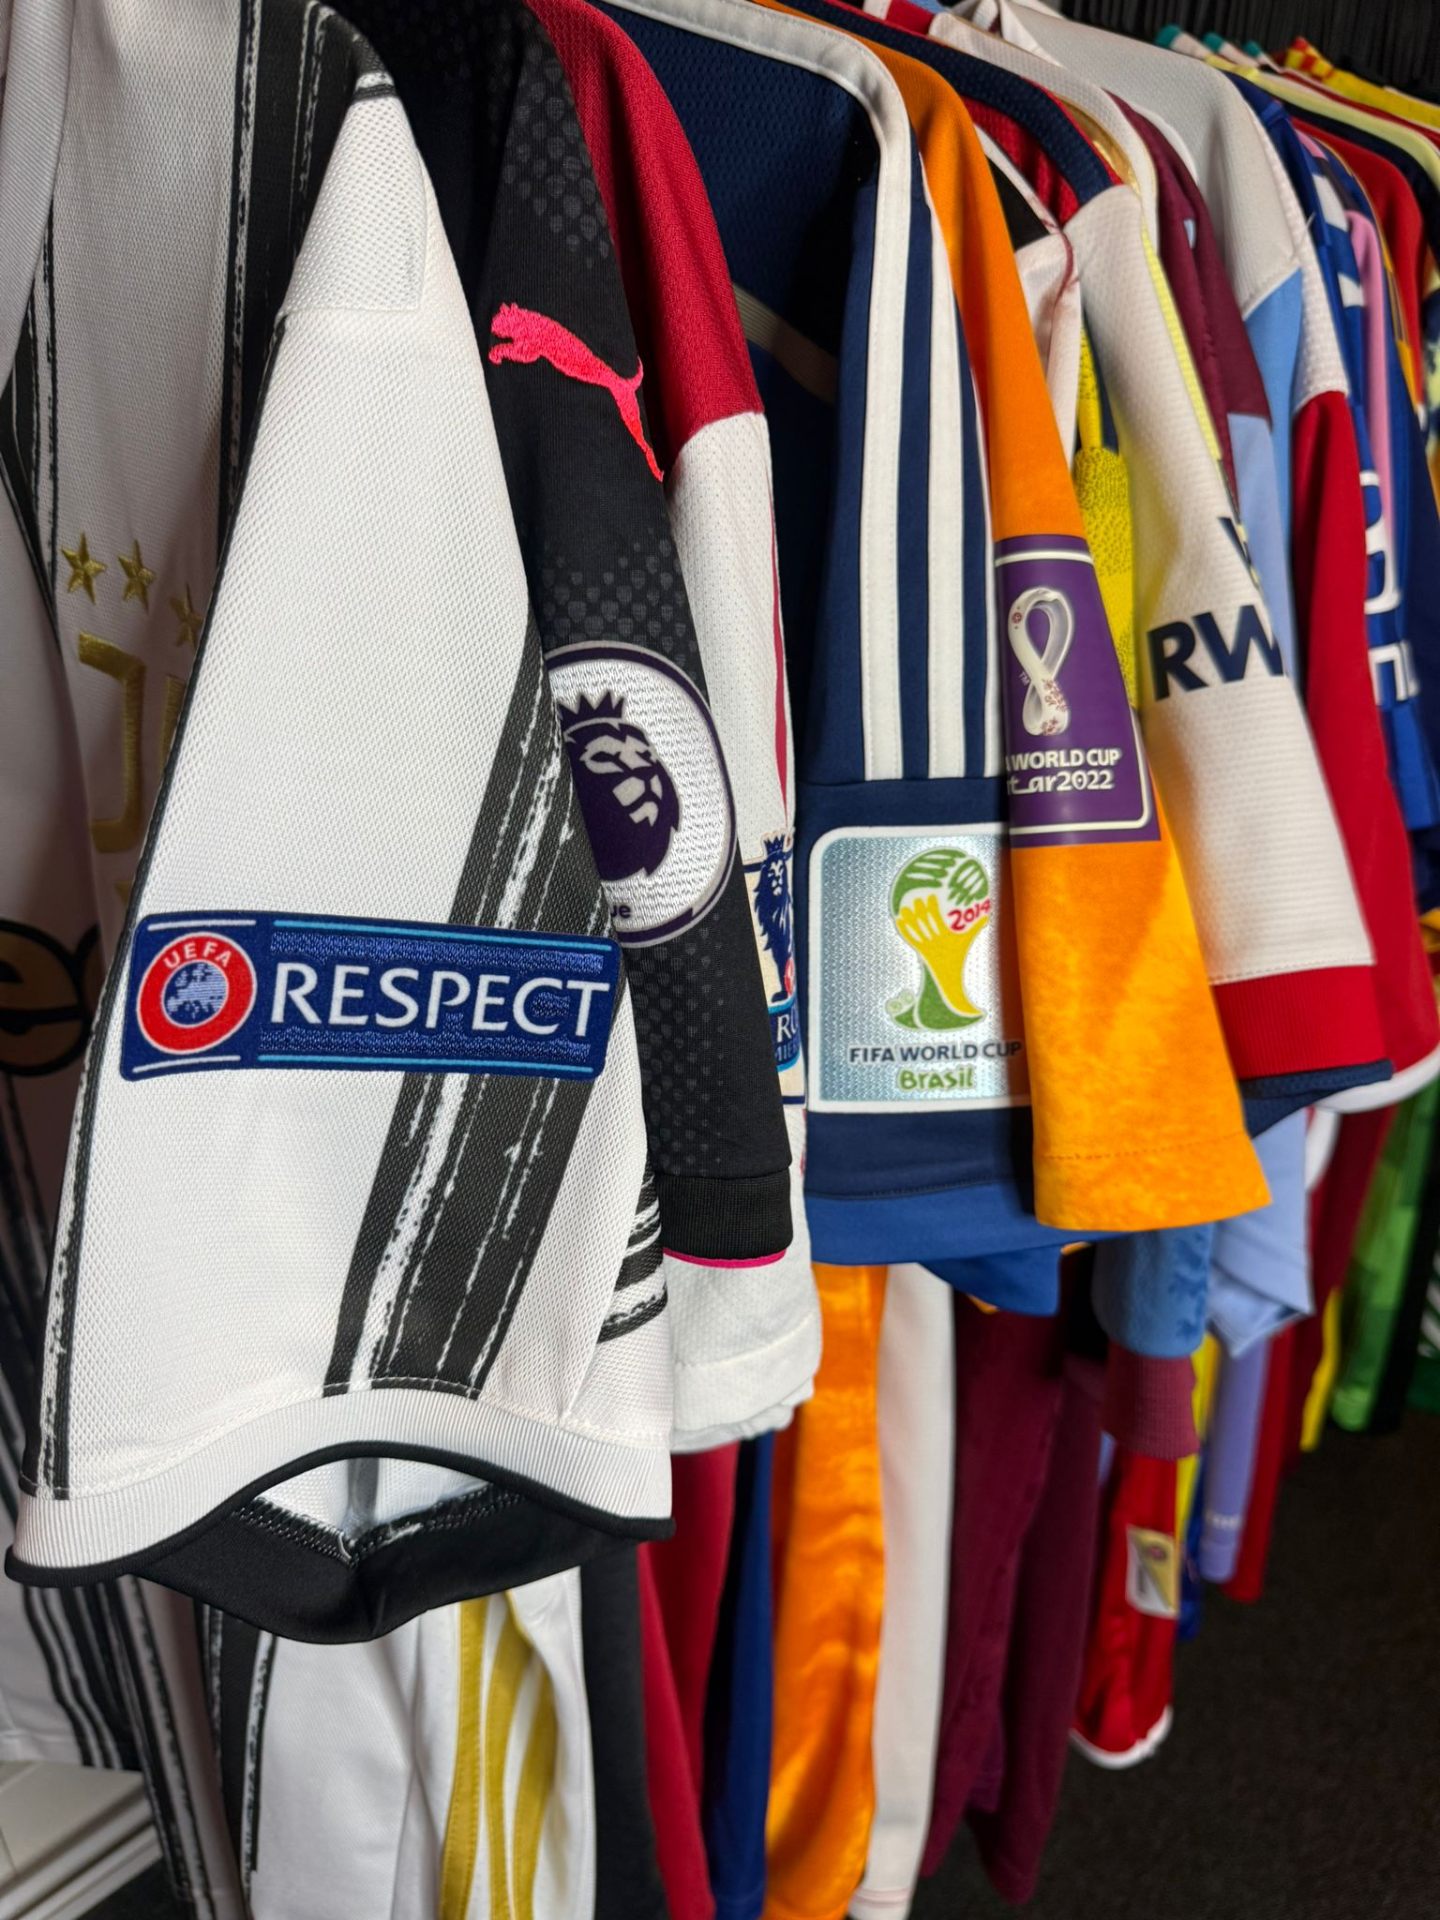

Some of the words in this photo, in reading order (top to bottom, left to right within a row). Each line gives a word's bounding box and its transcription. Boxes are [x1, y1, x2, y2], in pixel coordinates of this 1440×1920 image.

[1011, 748, 1084, 771] WORLD
[1086, 748, 1121, 766] CUP
[1006, 769, 1115, 796] tar2022
[947, 898, 992, 931] 2014
[163, 941, 234, 969] UEFA
[270, 962, 611, 1038] RESPECT
[850, 1048, 895, 1063] FIFA
[899, 1045, 978, 1061] WORLD
[982, 1042, 1022, 1057] CUP
[899, 1066, 975, 1091] Brasil
